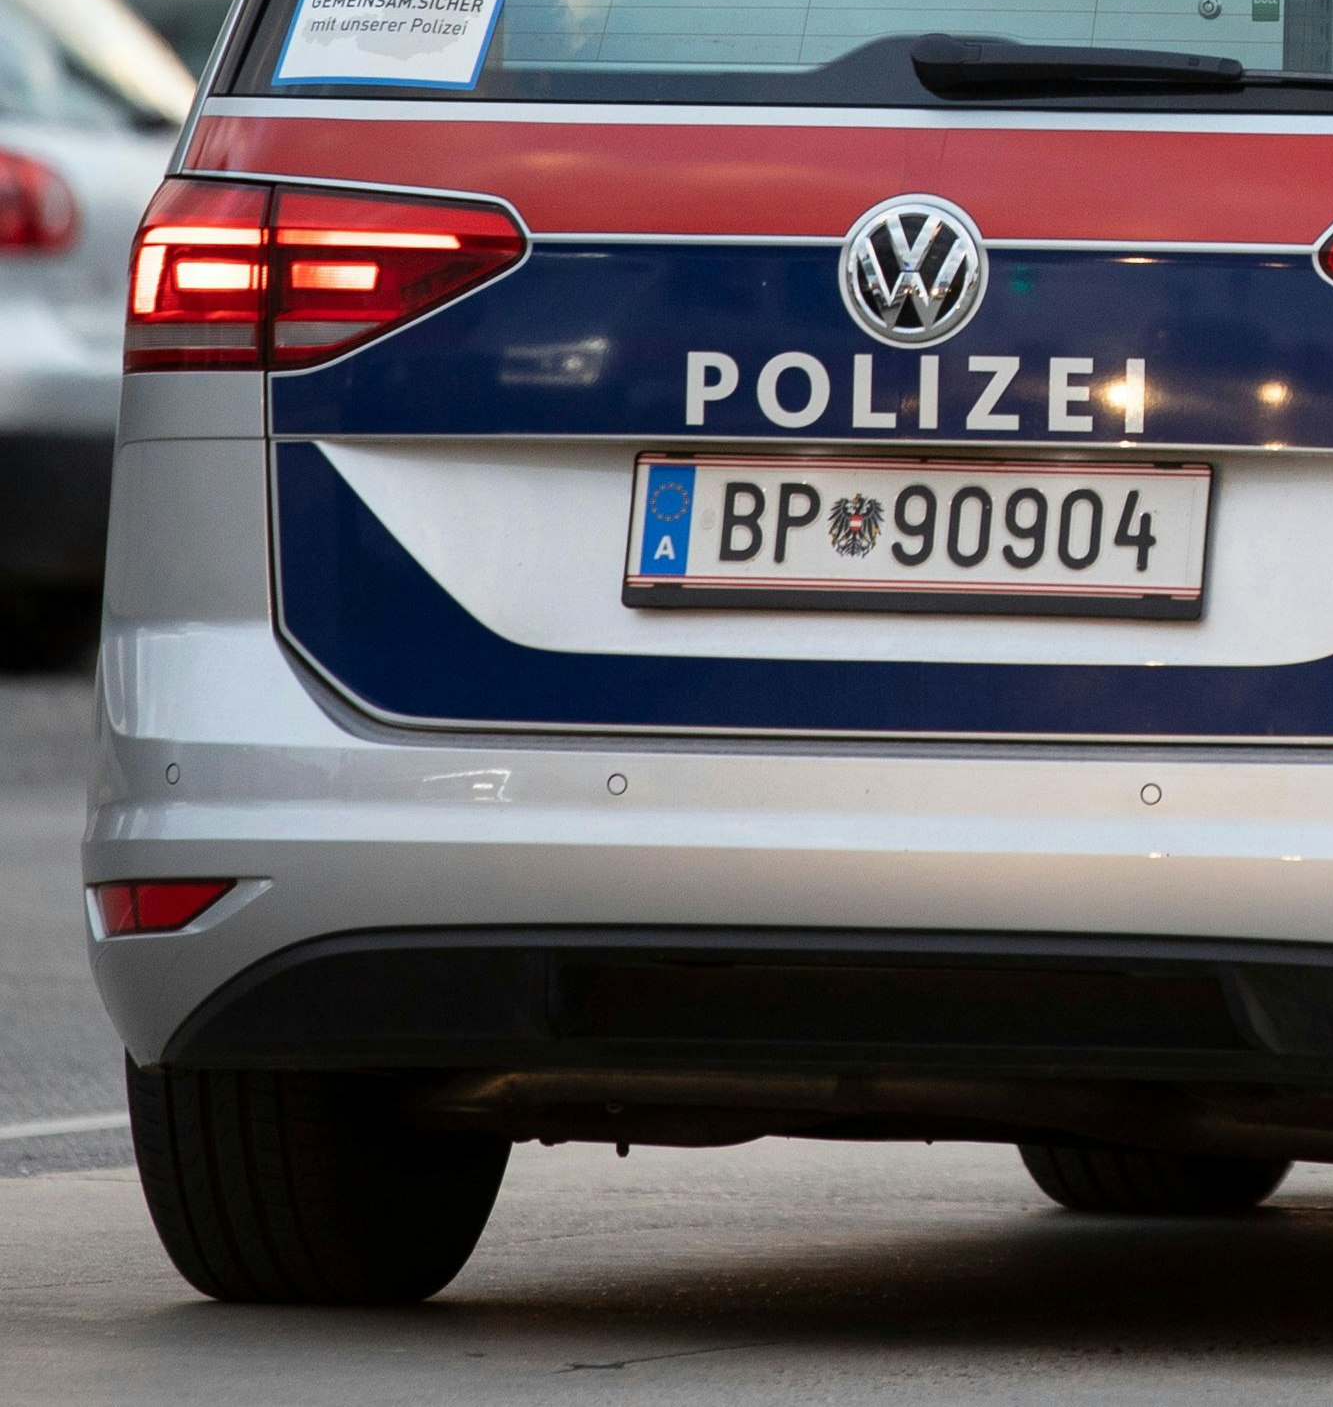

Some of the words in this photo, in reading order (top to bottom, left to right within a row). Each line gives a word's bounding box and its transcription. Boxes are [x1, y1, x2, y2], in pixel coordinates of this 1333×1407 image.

[310, 18, 337, 33] mit
[341, 20, 406, 33] unserer
[410, 18, 468, 35] Polizei
[856, 211, 968, 331] VW
[685, 351, 1146, 434] POLIZEI
[654, 535, 677, 561] A
[718, 481, 823, 565] BP
[891, 484, 1158, 573] 90904
